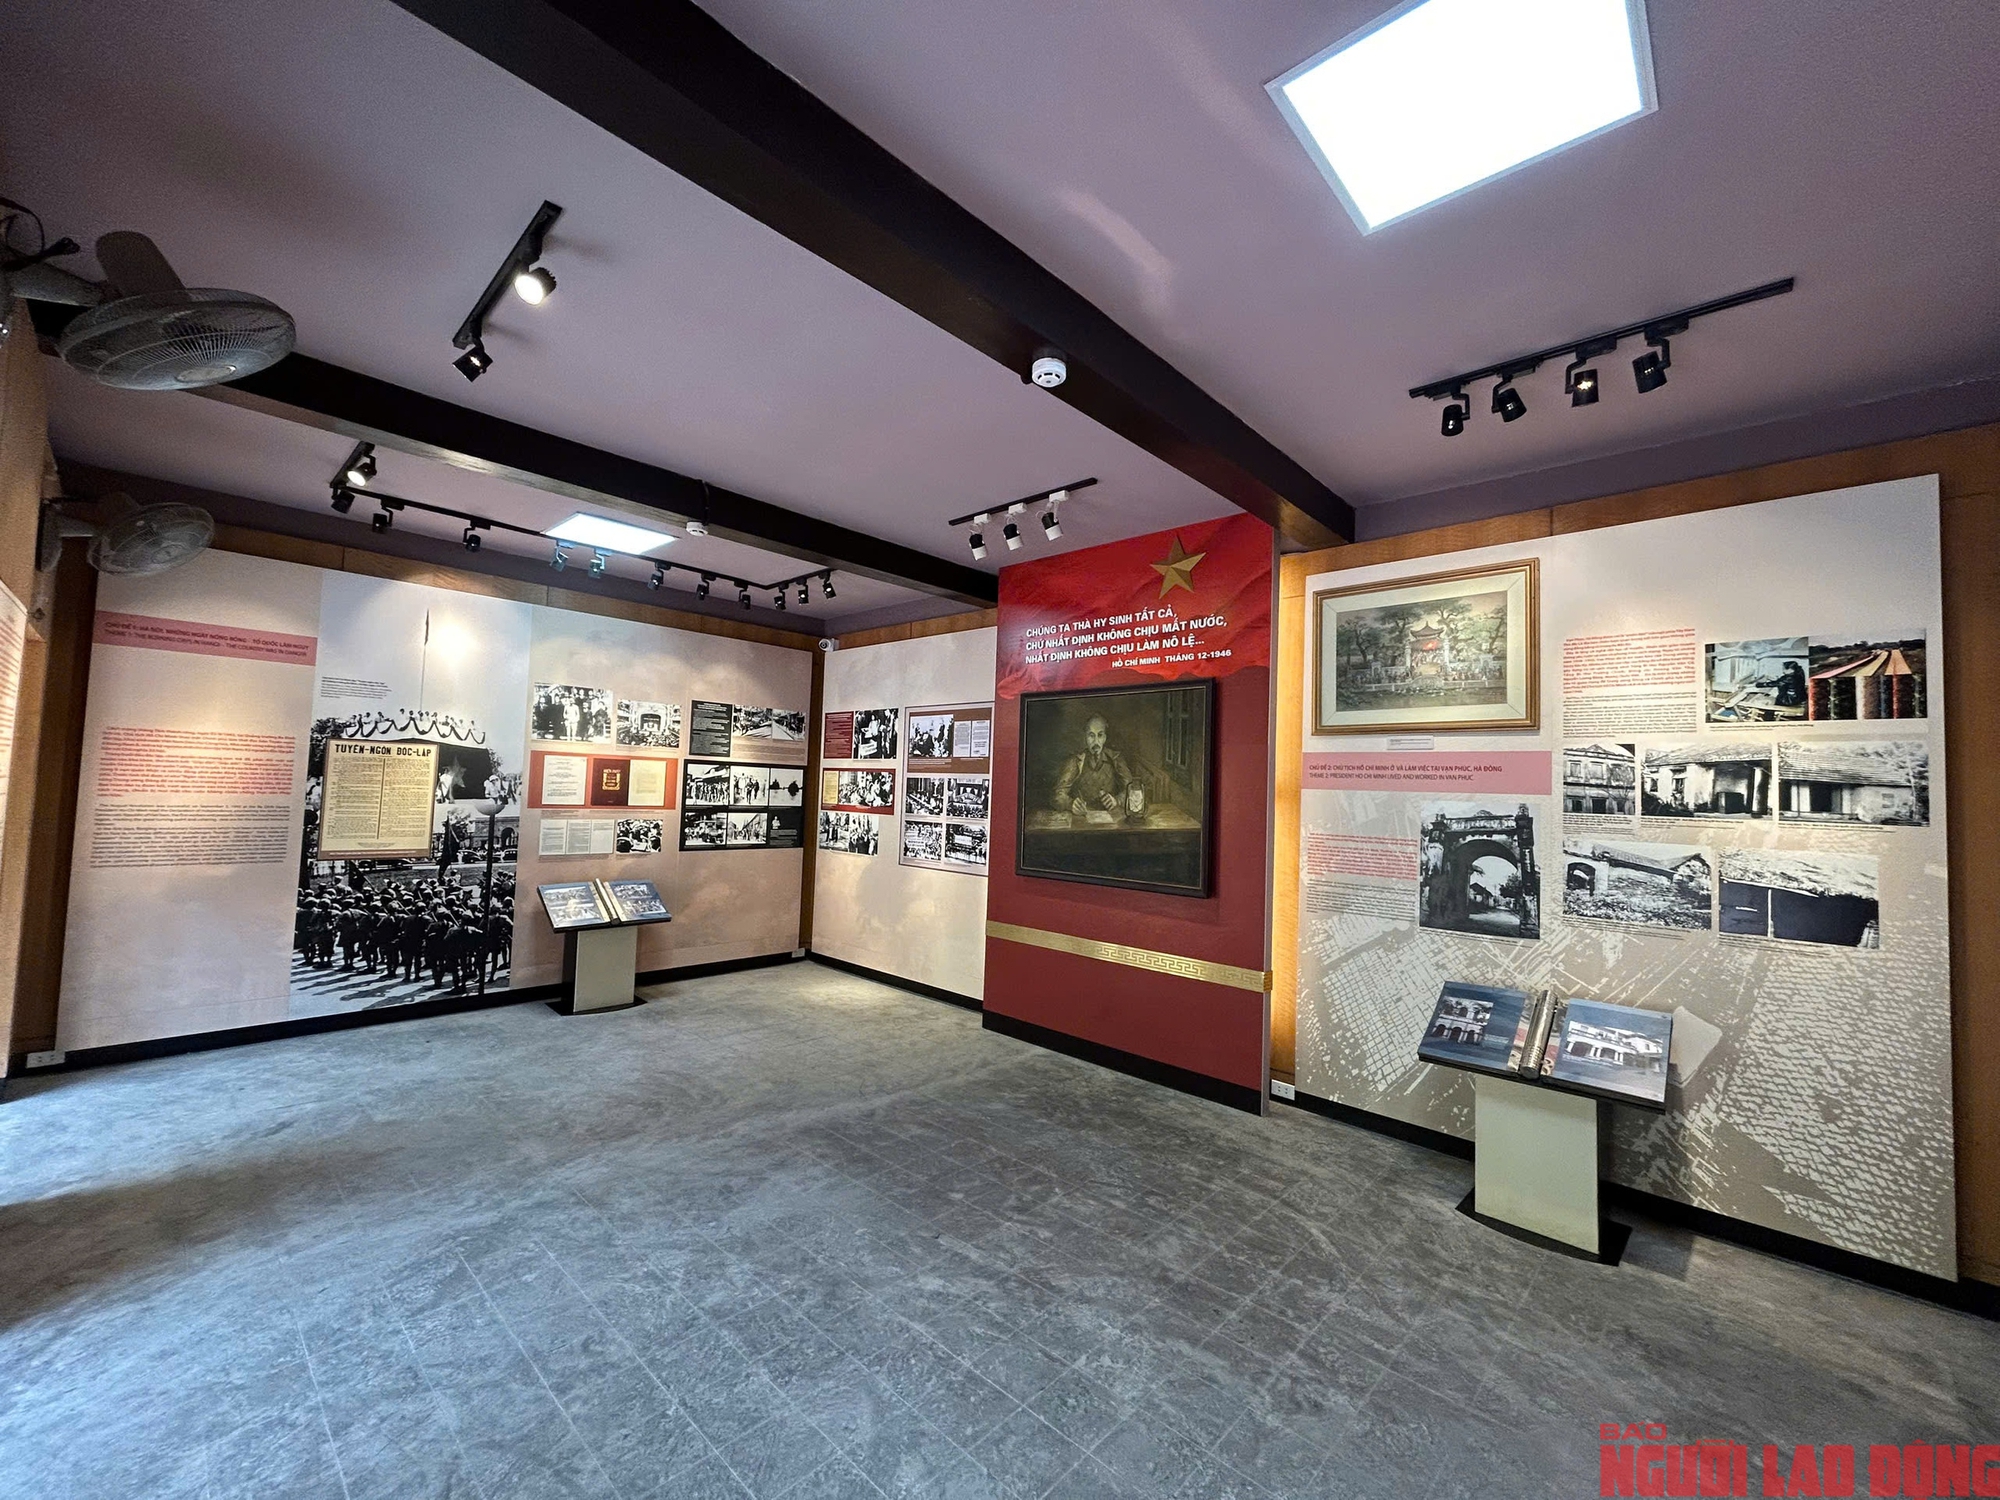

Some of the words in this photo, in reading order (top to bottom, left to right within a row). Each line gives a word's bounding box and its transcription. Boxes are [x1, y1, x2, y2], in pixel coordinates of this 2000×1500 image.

[1026, 624, 1056, 637] CHÚNG
[1058, 623, 1070, 633] TA
[1072, 618, 1091, 631] THÀ
[1093, 617, 1107, 628] HY
[1109, 613, 1132, 625] SINH
[1135, 606, 1155, 621] TẤT
[1157, 603, 1177, 618] CẢ,
[1026, 638, 1044, 650] CHỨ
[1045, 633, 1070, 648] NHẤT
[1071, 633, 1095, 646] ĐỊNH
[1096, 628, 1132, 641] KHÔNG
[1134, 625, 1159, 637] CHỊU
[1162, 617, 1187, 633] MẤT
[1189, 613, 1227, 630] NƯỚC,
[1025, 650, 1050, 664] NHẤT
[1050, 650, 1073, 662] ĐỊNH
[1074, 645, 1108, 658] KHÔNG
[1110, 642, 1134, 655] CHỊU
[1136, 639, 1159, 651] LÀM
[1162, 635, 1178, 648] NÔ
[1181, 633, 1205, 647] LỆ...
[1112, 657, 1123, 668] HỒ
[1124, 657, 1138, 666] CHÍ
[1139, 656, 1160, 665] MINH
[1165, 651, 1194, 663] THÁNG
[1197, 649, 1232, 660] 12-1946
[1483, 764, 1503, 773] ĐÔNG
